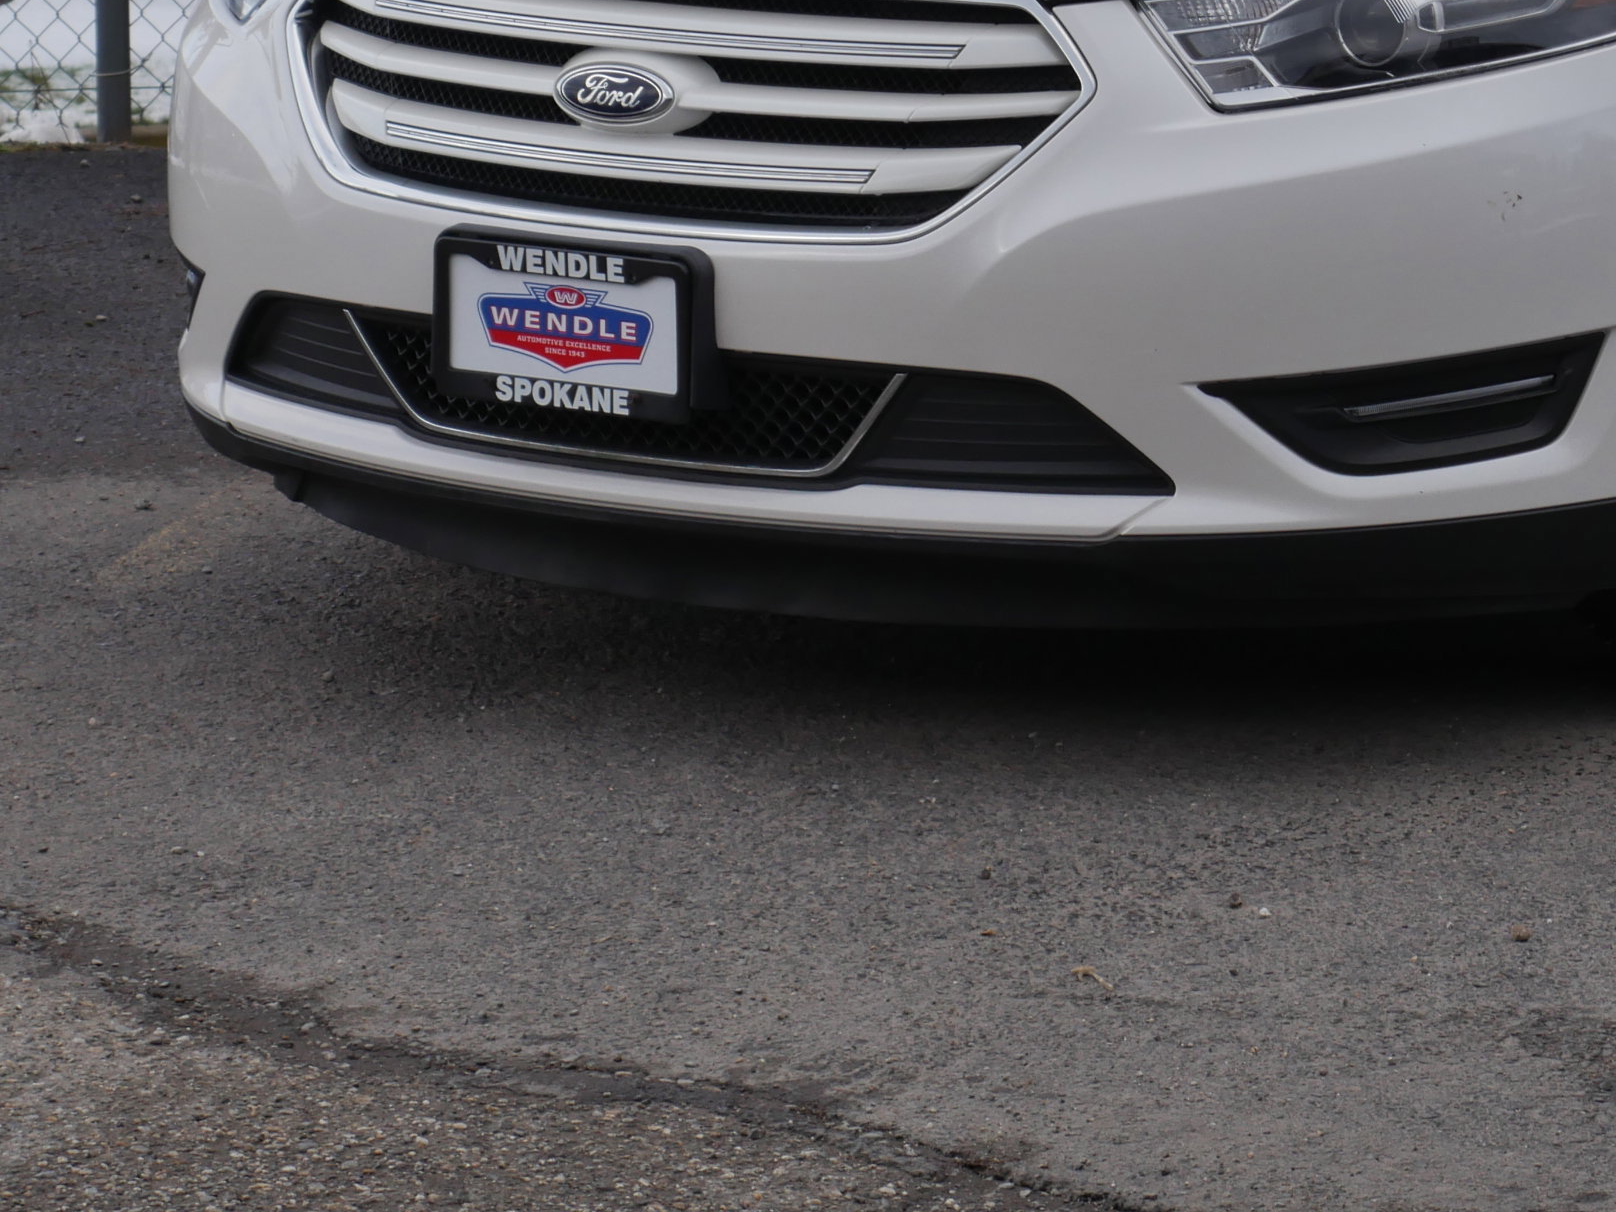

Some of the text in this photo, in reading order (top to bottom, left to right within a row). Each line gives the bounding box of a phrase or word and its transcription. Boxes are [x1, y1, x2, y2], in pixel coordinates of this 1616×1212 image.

[577, 74, 643, 108] Ford
[497, 245, 625, 283] WENDLE
[490, 305, 637, 341] WENDLE
[517, 335, 611, 352] AUTOMOTIVE EXCELLENCE
[545, 347, 585, 358] SINCE 1943
[495, 375, 629, 416] SPOKANE
